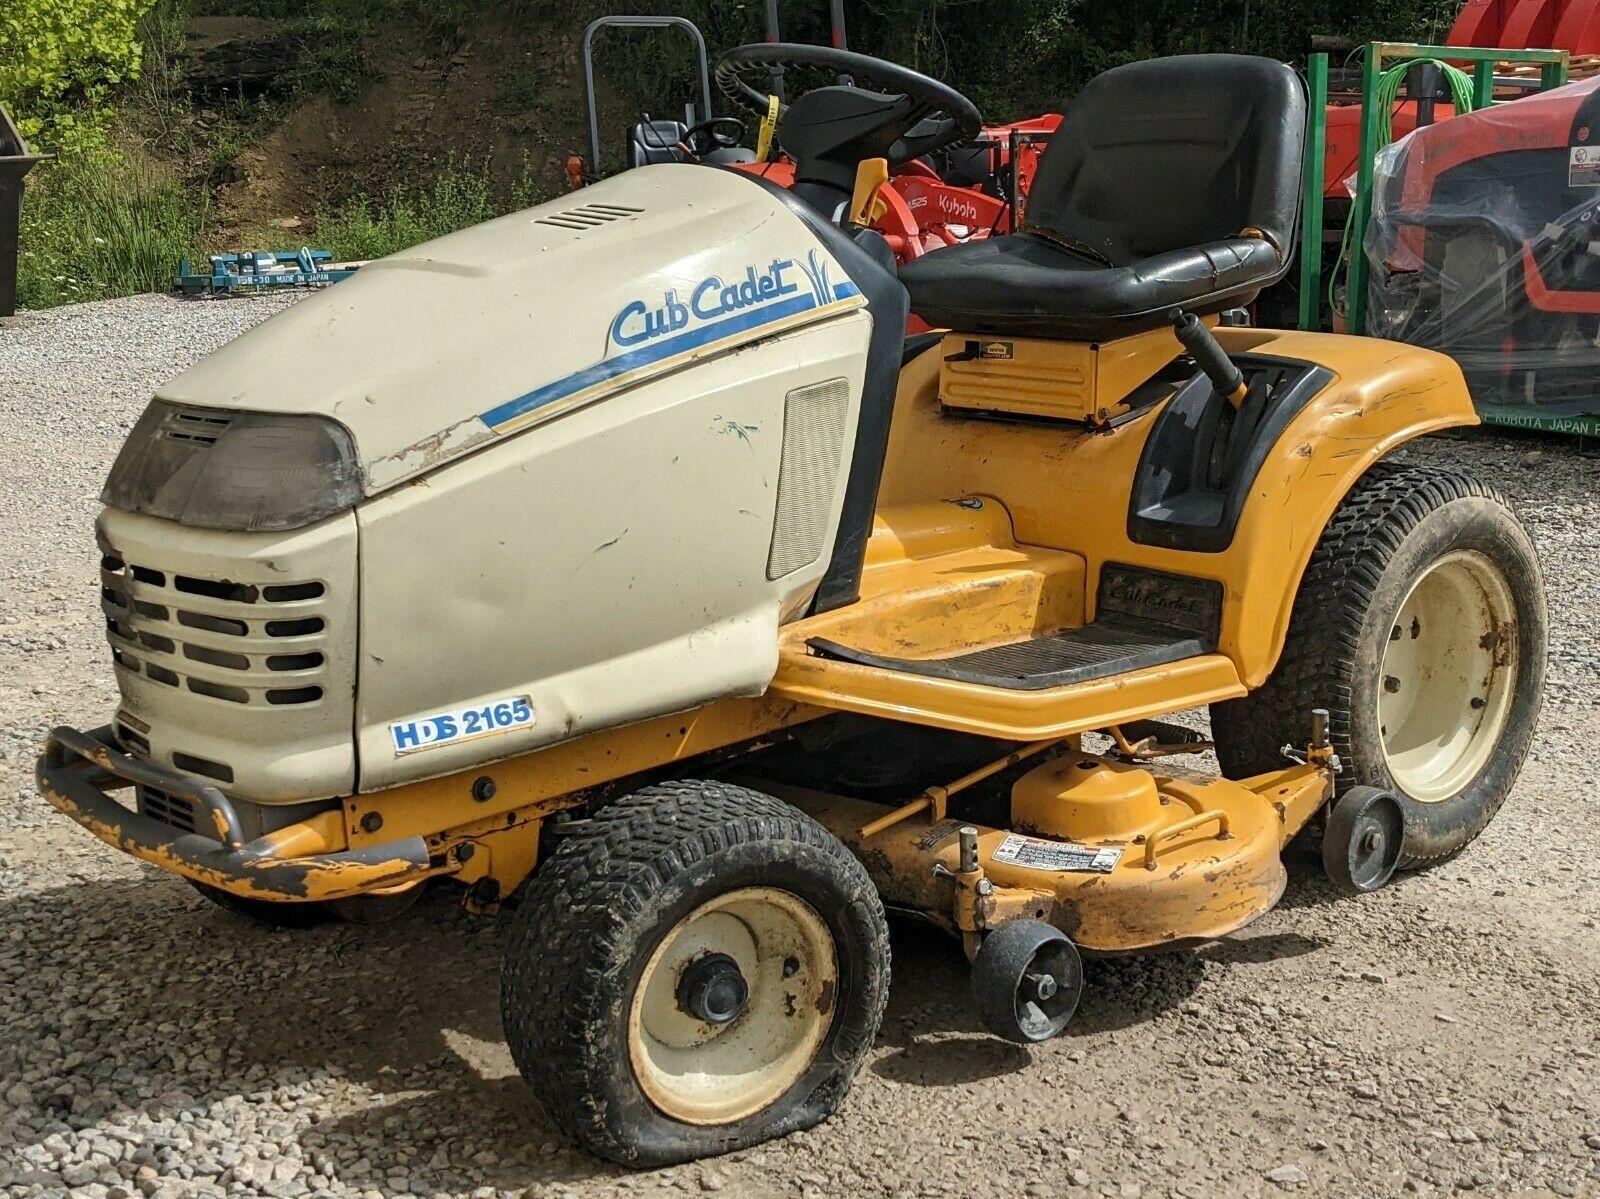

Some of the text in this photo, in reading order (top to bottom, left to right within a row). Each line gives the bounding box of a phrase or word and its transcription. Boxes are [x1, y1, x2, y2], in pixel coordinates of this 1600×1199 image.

[939, 194, 977, 220] Kubota
[276, 274, 294, 283] MADE
[308, 273, 329, 281] JAPAN
[612, 257, 798, 346] Cub Cadet
[1495, 414, 1542, 429] KUBOTA
[1548, 417, 1589, 434] JAPAN
[393, 698, 531, 749] HDS 2165
